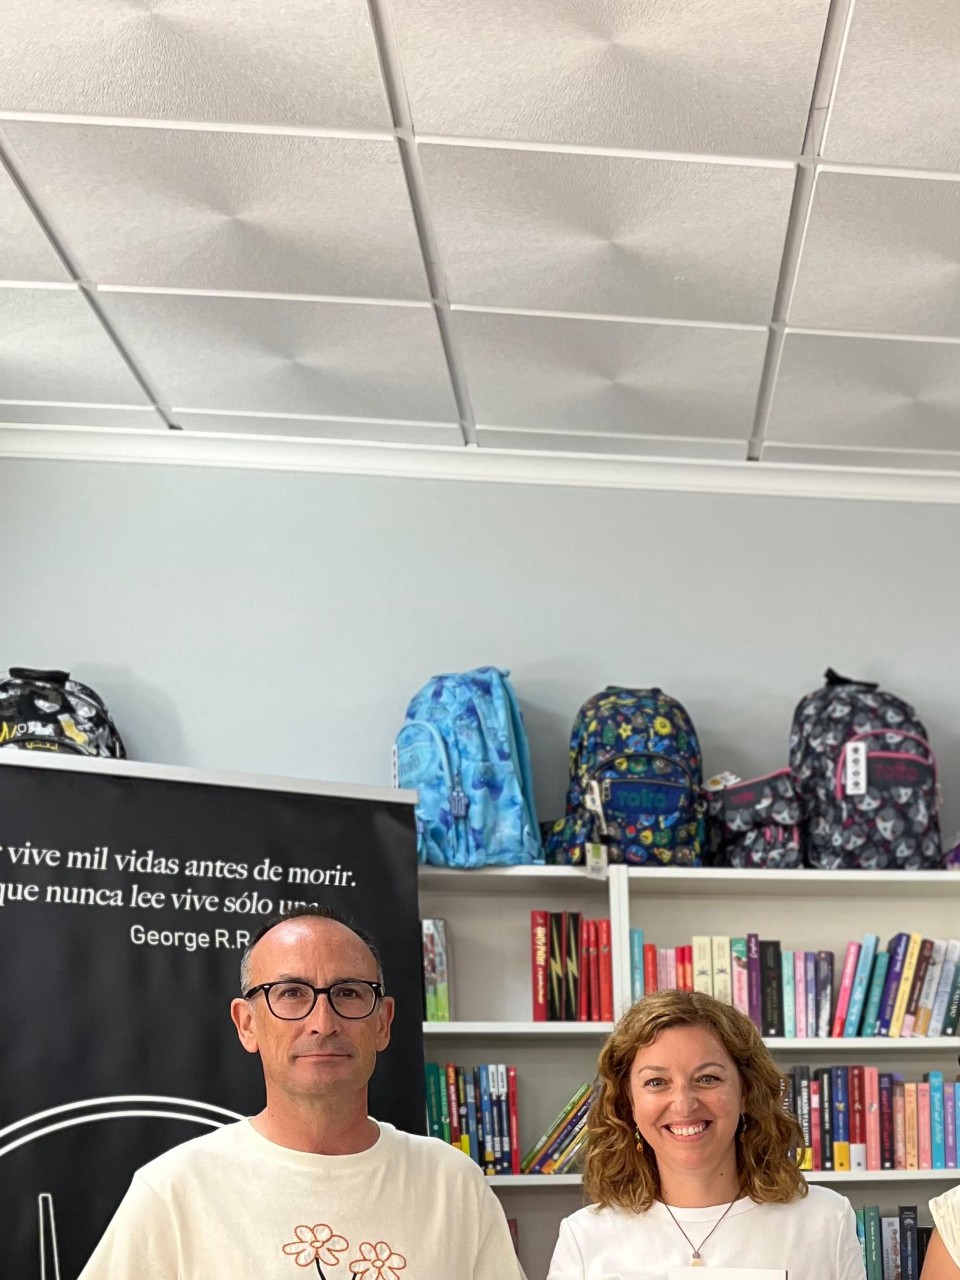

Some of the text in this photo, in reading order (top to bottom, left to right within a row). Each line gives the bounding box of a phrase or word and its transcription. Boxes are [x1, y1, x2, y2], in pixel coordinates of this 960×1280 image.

[7, 842, 356, 887] vive mil vidas antes de morir.
[45, 885, 124, 907] nunca
[129, 884, 166, 909] lee
[170, 887, 219, 912] vive
[223, 891, 273, 915] sólo
[130, 924, 210, 952] George
